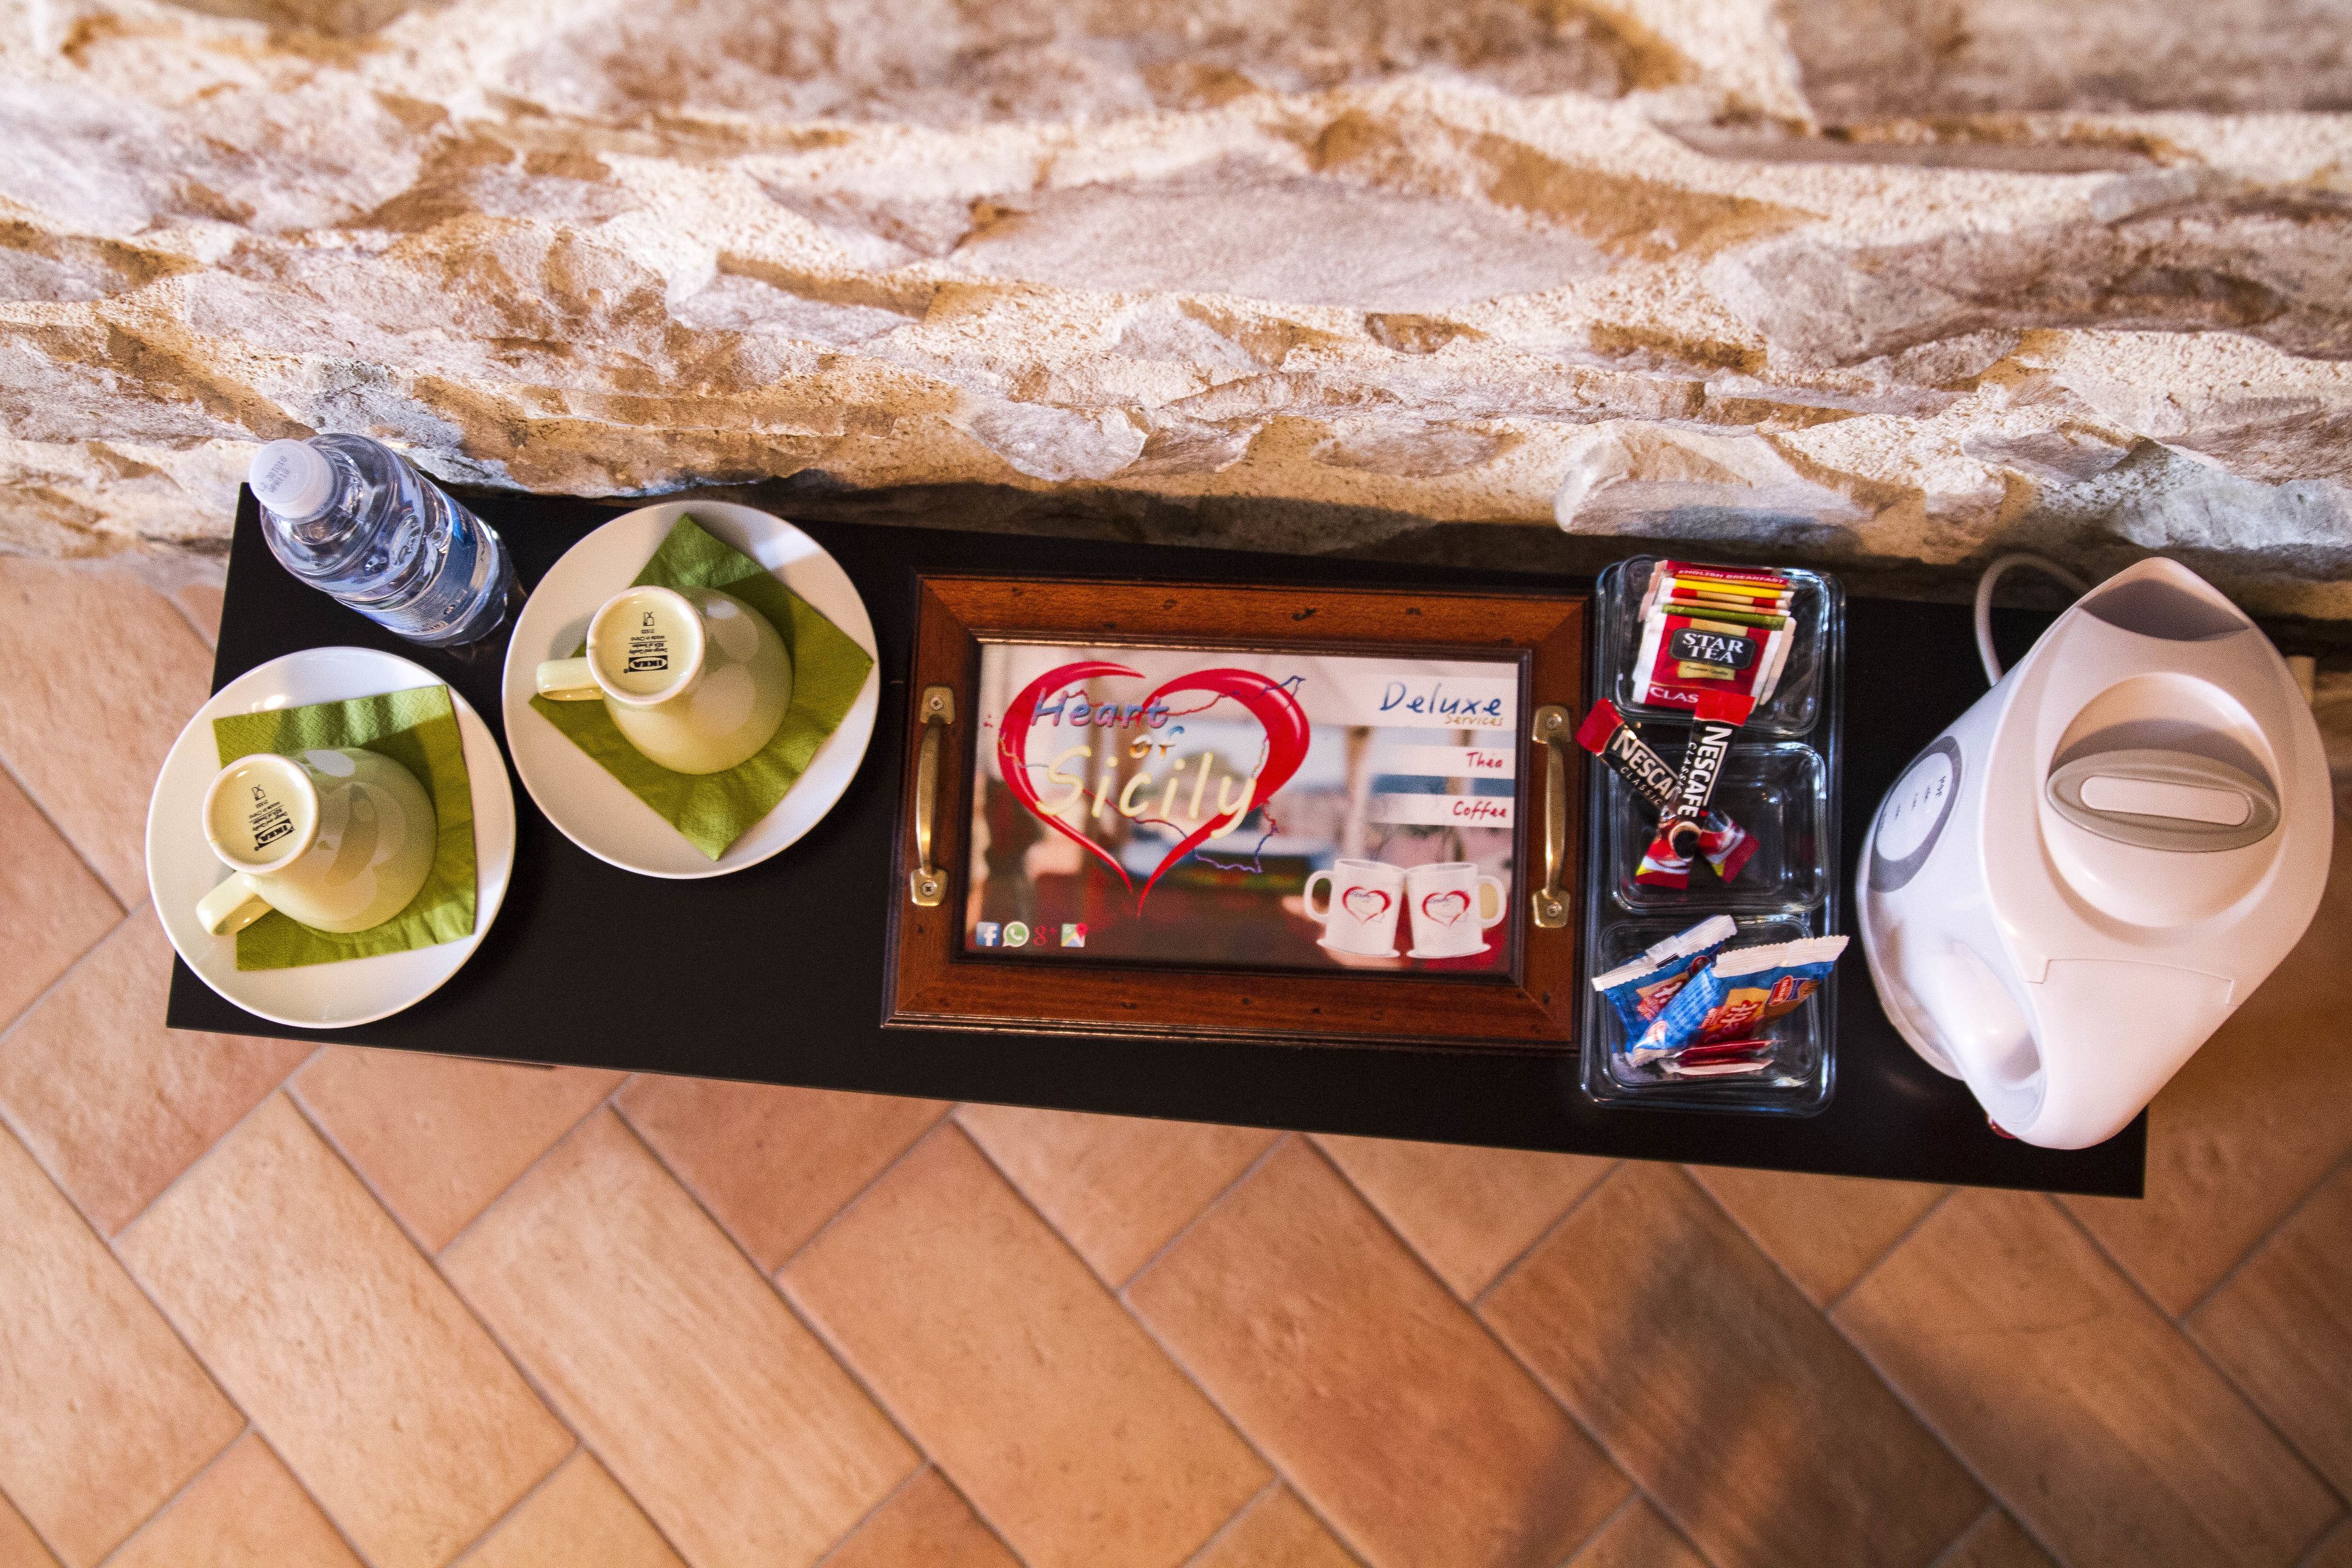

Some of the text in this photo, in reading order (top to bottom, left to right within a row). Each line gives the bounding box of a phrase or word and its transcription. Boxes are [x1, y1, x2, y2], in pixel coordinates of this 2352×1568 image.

[1678, 570, 1785, 584] ENGLISH BREAKFAST
[1683, 633, 1744, 654] STAR
[1687, 646, 1735, 664] TEA
[1380, 681, 1502, 716] Deluxe
[1649, 687, 1700, 703] CLAS
[1031, 687, 1170, 728] Heart
[1445, 712, 1504, 726] Services
[1129, 726, 1185, 760] of
[1611, 734, 1679, 800] NESCA
[1037, 745, 1257, 840] Sicily
[1620, 767, 1664, 805] CLASSIC
[1452, 801, 1507, 820] Coffee
[260, 824, 288, 842] IKEA
